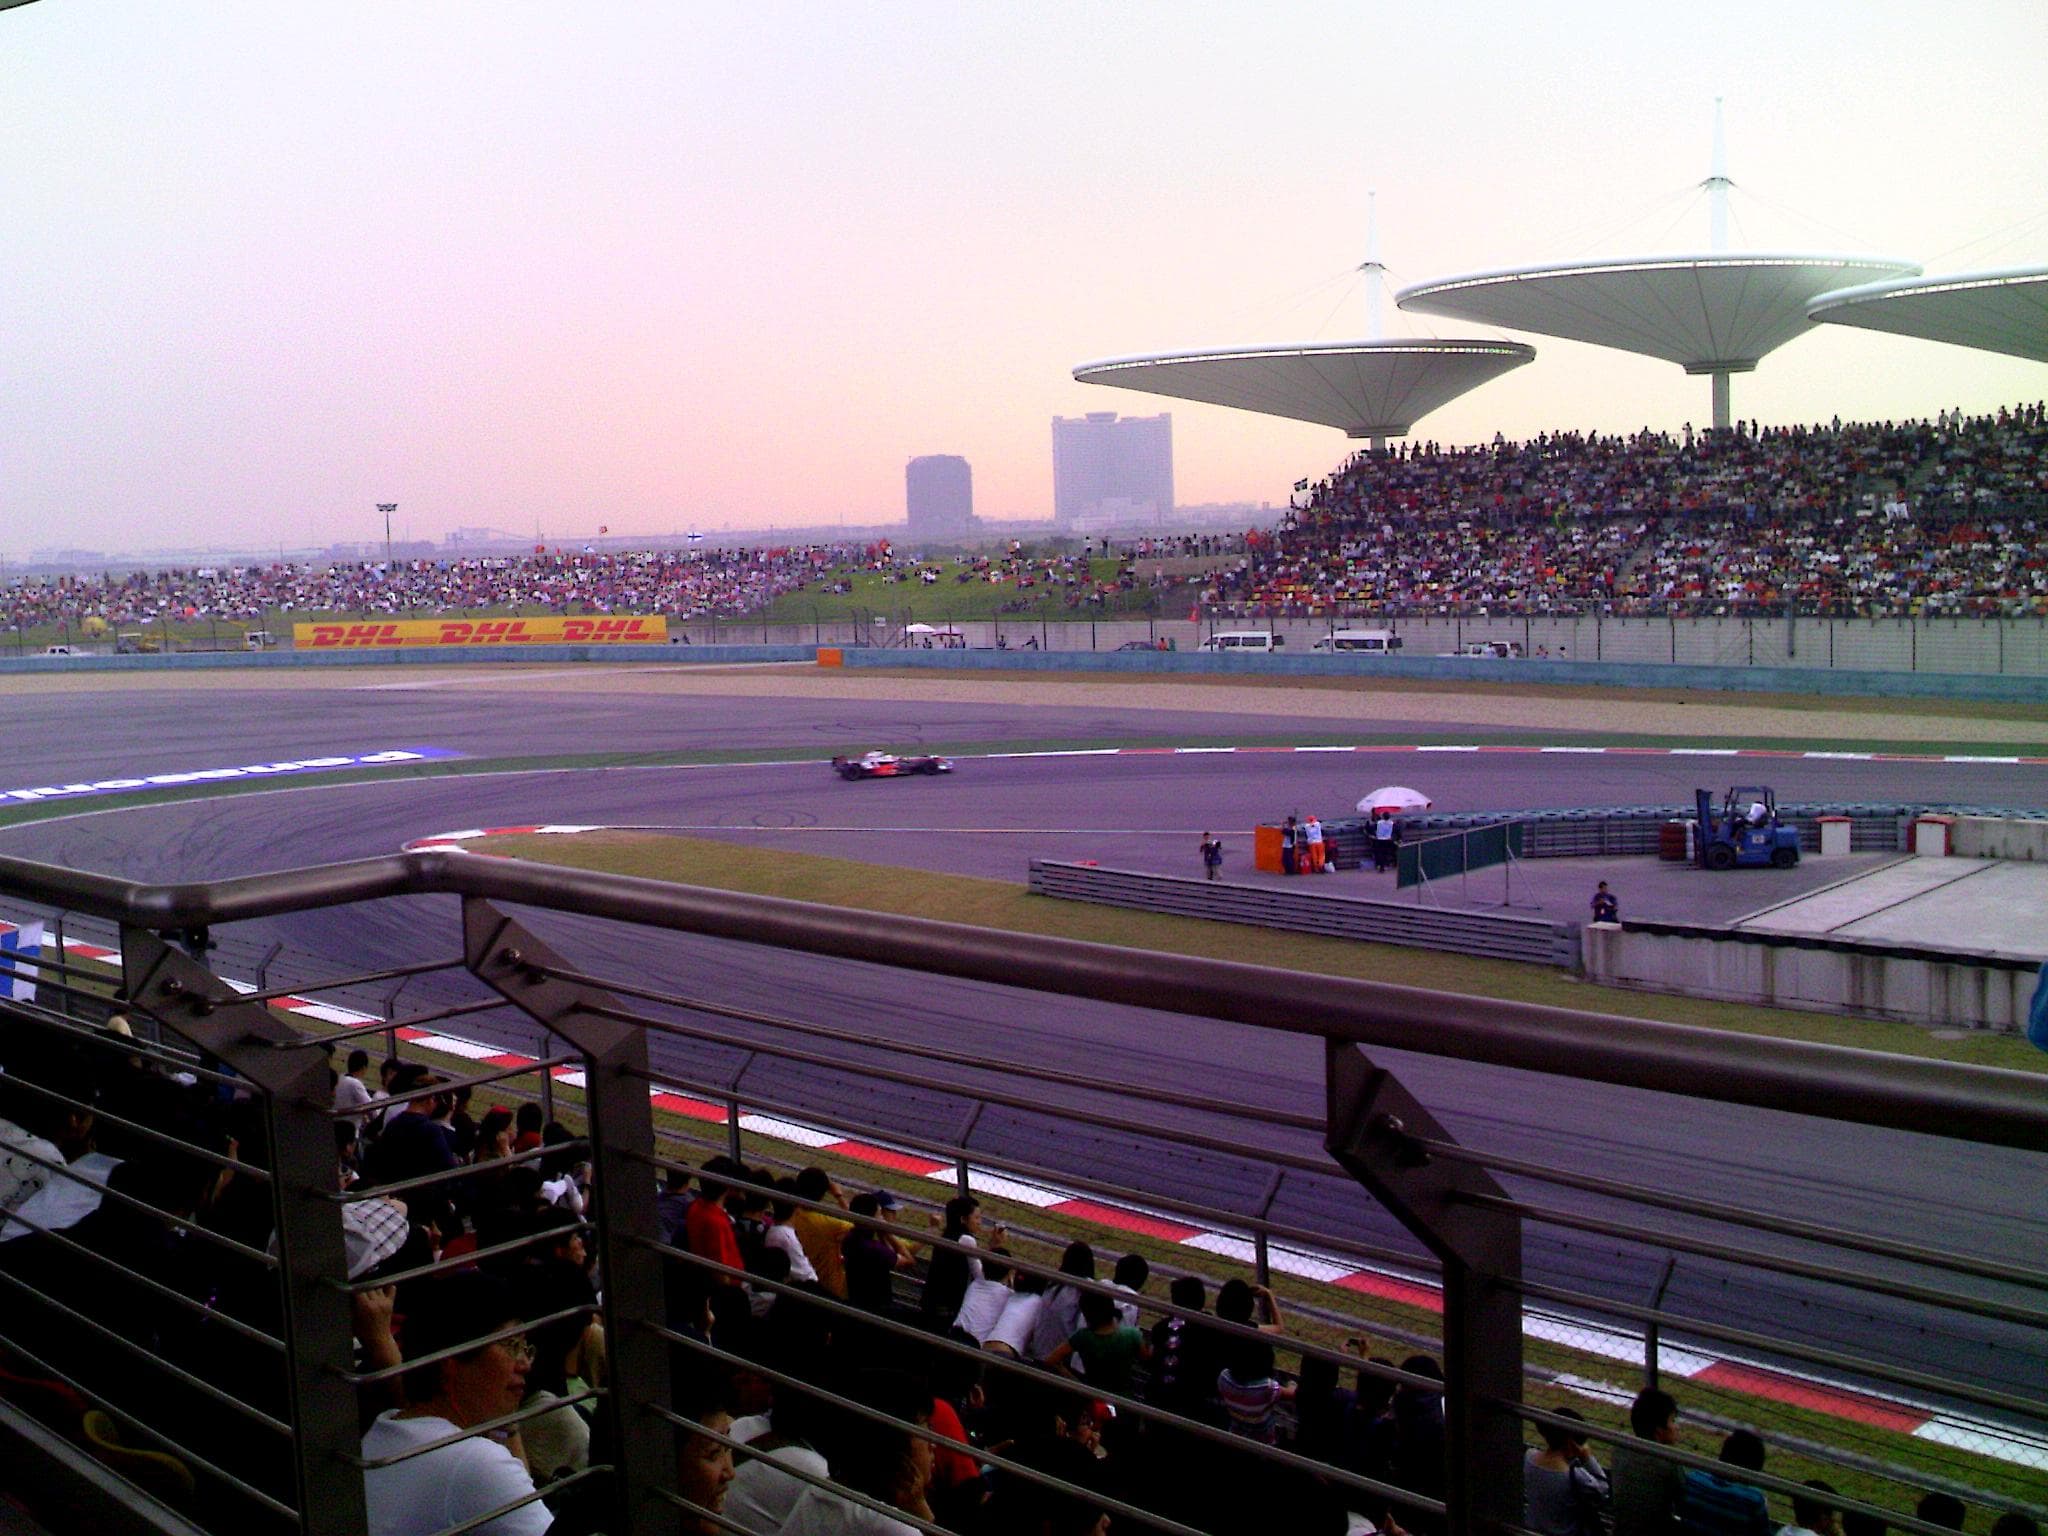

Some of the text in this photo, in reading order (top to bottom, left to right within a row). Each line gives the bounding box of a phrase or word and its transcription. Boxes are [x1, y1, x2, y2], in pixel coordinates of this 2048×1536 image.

[313, 620, 650, 646] DHL DHL DHL
[0, 751, 425, 799] Panasoni
